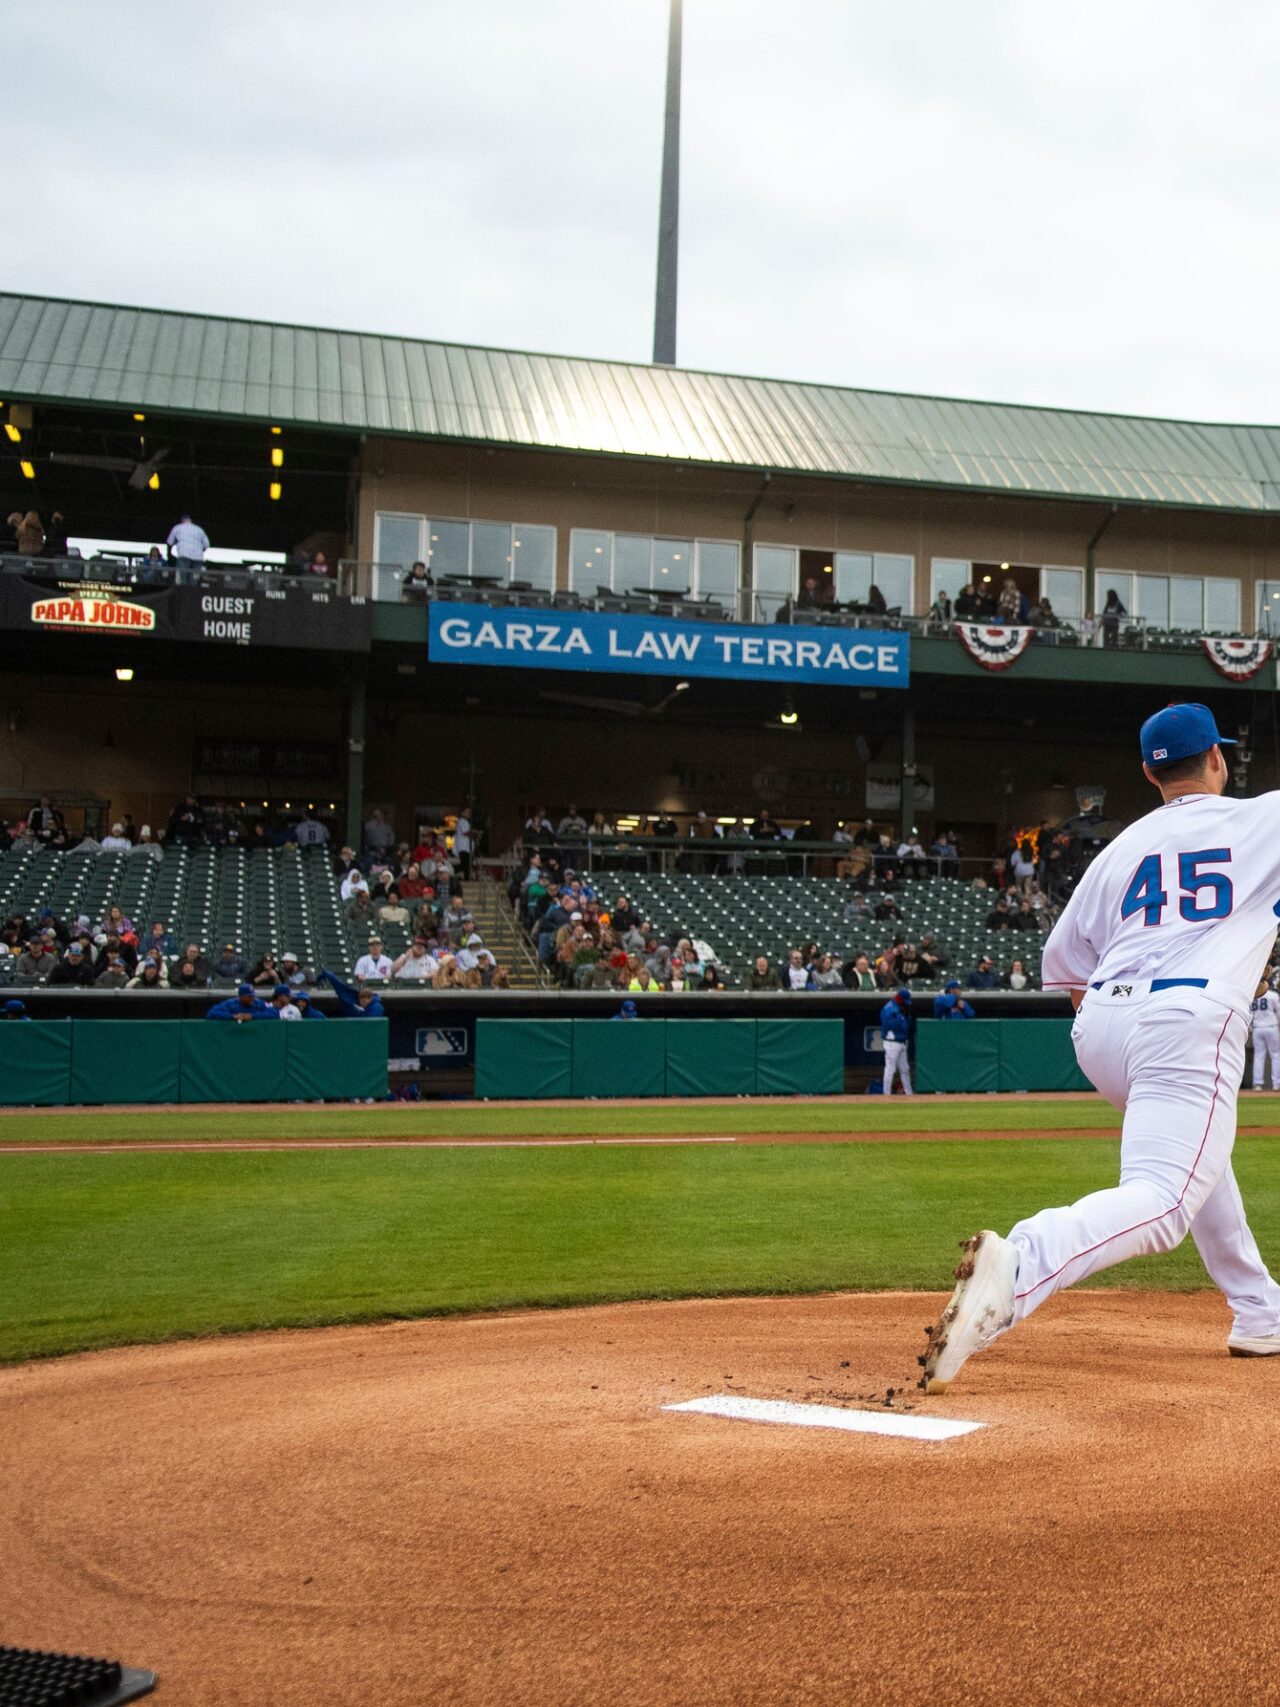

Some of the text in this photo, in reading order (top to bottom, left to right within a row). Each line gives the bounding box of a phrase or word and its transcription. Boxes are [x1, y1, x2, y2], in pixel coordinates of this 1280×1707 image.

[201, 595, 255, 614] GUEST
[265, 590, 286, 600] RUNS
[312, 593, 329, 603] HITS
[35, 600, 152, 627] PAPA JOHNS
[203, 620, 252, 639] HOME
[439, 618, 899, 673] GARZA LAW TERRACE
[1120, 847, 1233, 927] 45
